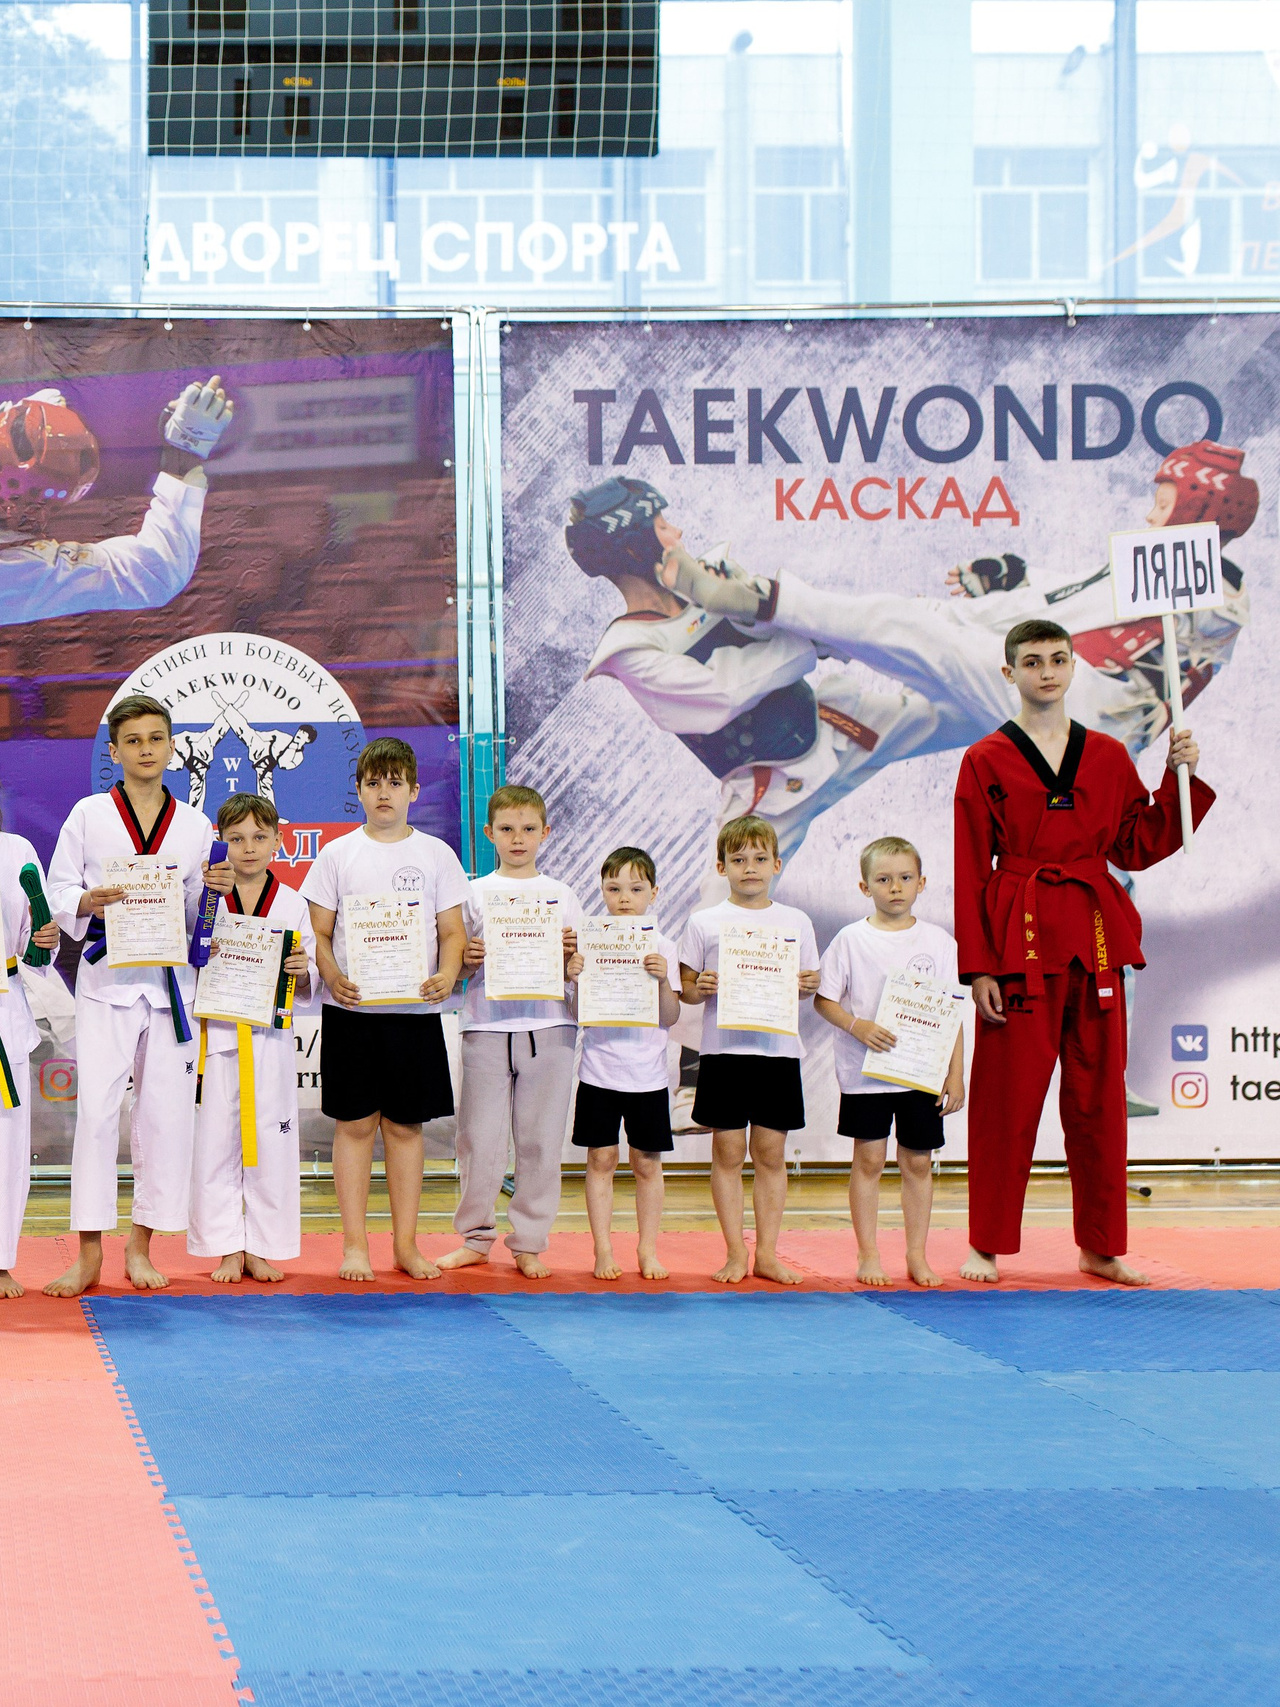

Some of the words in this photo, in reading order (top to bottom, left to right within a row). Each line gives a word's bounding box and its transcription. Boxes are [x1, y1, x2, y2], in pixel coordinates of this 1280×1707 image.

[148, 222, 398, 281] ДВОРЕЦ
[422, 222, 681, 273] СПОРТА
[573, 381, 1223, 466] TAEKWONDO
[775, 476, 1021, 527] КАСКАД
[1131, 538, 1215, 610] ЛЯДЫ
[129, 643, 208, 697] АСТИКИ
[220, 641, 233, 655] И
[245, 641, 329, 695] БОЕВЫХ
[161, 672, 301, 711] TAEKWONDO
[111, 883, 157, 891] TAEKWONDO
[161, 882, 171, 890] WT
[203, 889, 217, 929] TAEKWO
[353, 920, 398, 930] TAEKWONDO
[402, 919, 414, 927] WT
[492, 917, 536, 925] TAEKWONDO
[214, 937, 257, 951] TAEKWONDO
[261, 943, 272, 951] WT
[363, 935, 408, 943] СЕРТИФИКАТ
[586, 943, 631, 951] TAEKWONDO
[635, 943, 646, 951] WT
[1093, 910, 1109, 972] TAEKWONDO
[220, 953, 264, 964] СЕРТИФИКАТ
[737, 964, 782, 973] СЕРТИФИКАТ
[890, 995, 936, 1013] TAEKWONDO
[940, 1009, 952, 1018] WT
[895, 1012, 941, 1029] СЕРТИФИКАТ
